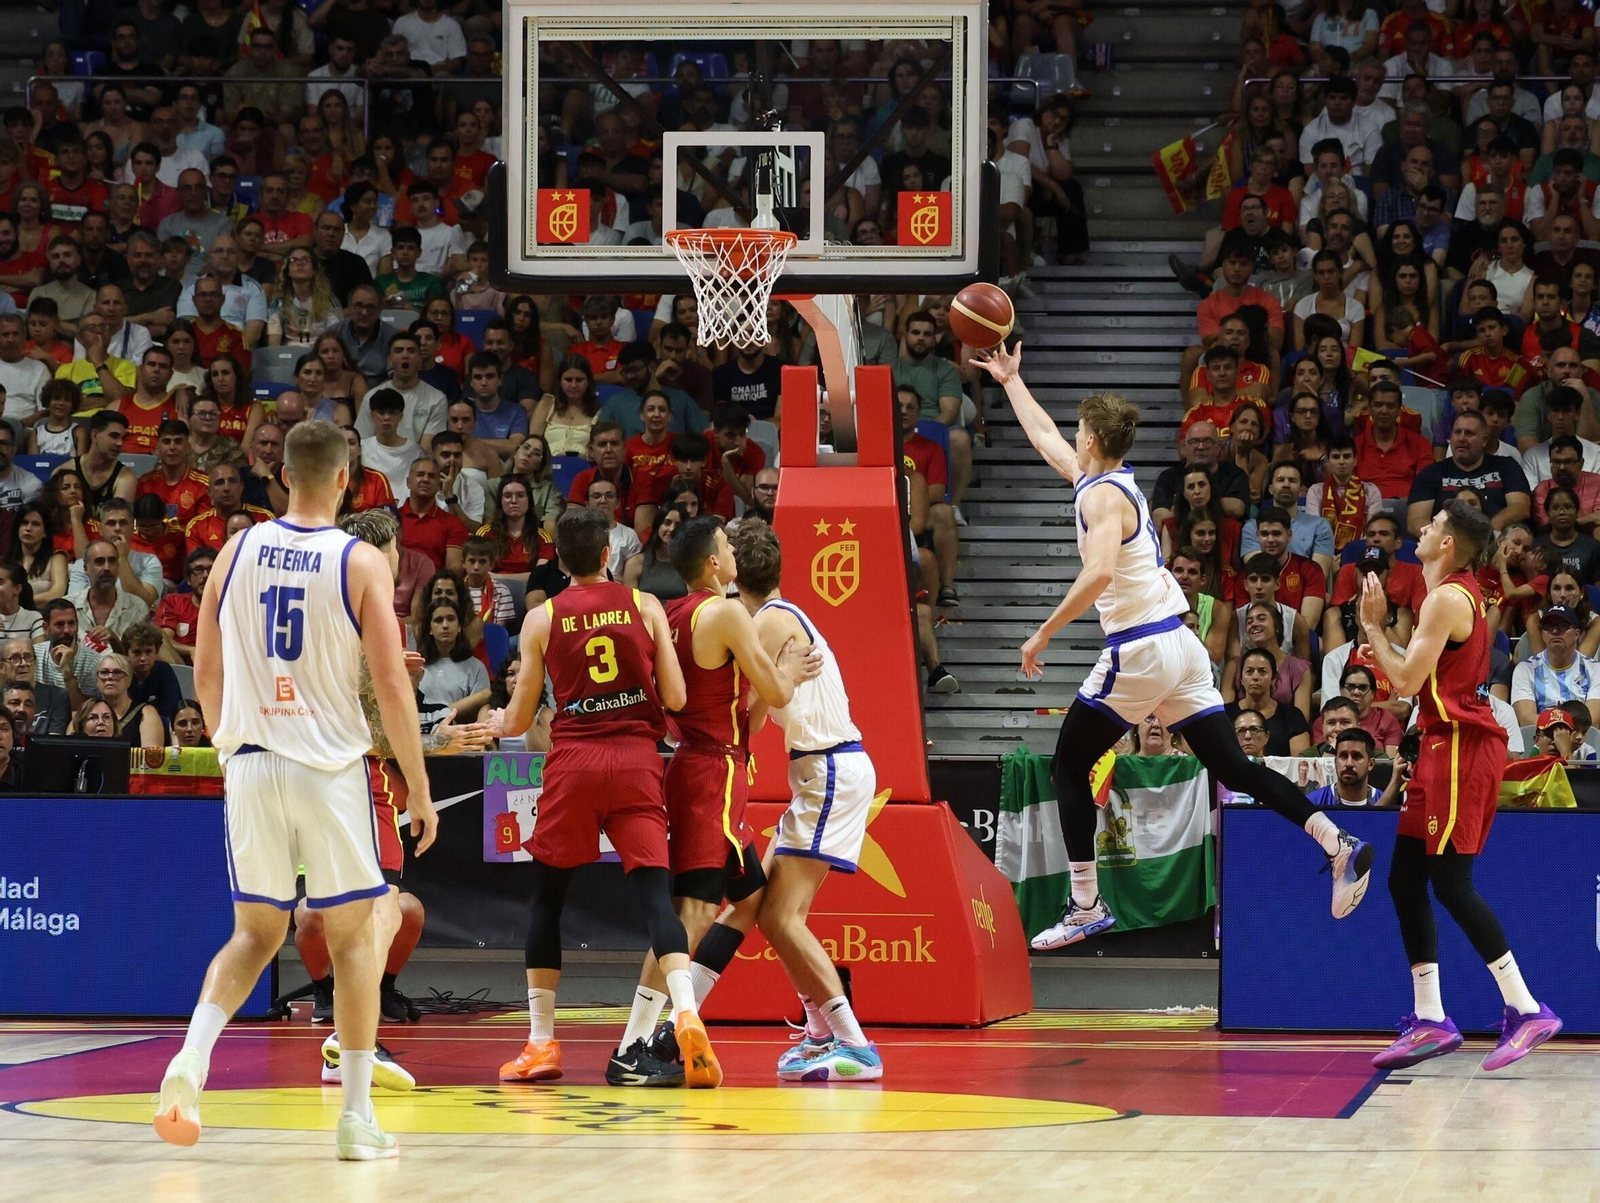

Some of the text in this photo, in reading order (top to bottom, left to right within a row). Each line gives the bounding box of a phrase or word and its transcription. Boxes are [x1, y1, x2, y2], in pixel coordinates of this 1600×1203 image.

[731, 390, 768, 402] MATIQUE
[839, 544, 856, 552] FEB
[1055, 546, 1062, 554] 9
[1046, 586, 1053, 594] 8
[259, 584, 306, 662] 15
[561, 610, 632, 634] DE LARREA
[585, 635, 619, 684] 3
[582, 688, 648, 714] CaixaBank
[1012, 717, 1019, 725] 5
[502, 826, 513, 844] 9
